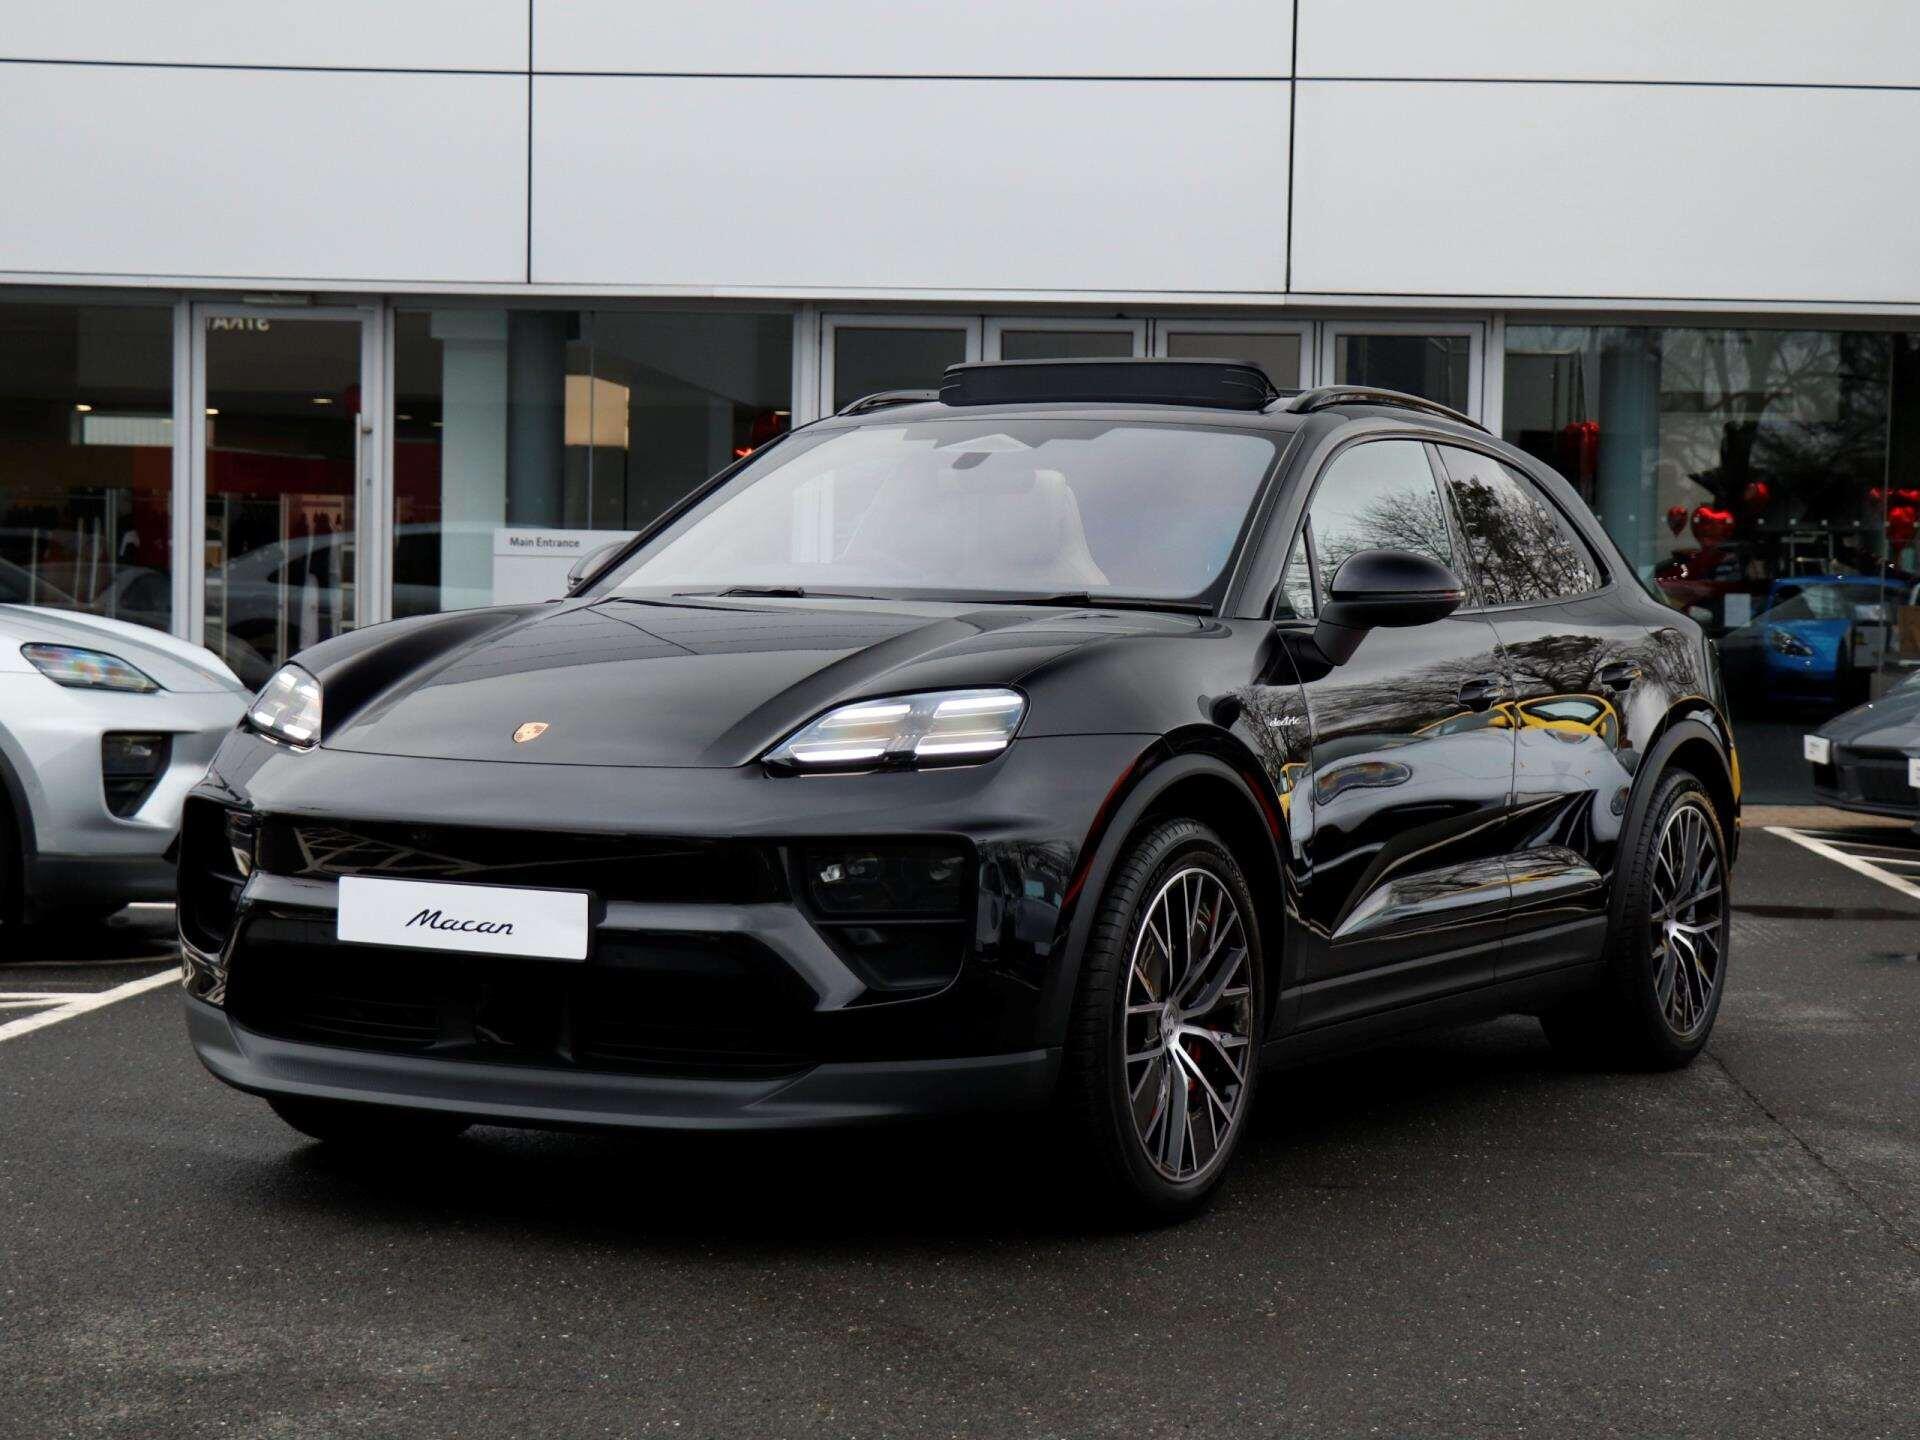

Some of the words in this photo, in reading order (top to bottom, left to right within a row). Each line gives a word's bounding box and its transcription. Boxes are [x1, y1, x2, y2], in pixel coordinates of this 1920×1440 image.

[510, 537, 534, 547] Main
[536, 538, 580, 548] Entrance
[405, 908, 514, 935] Macan
